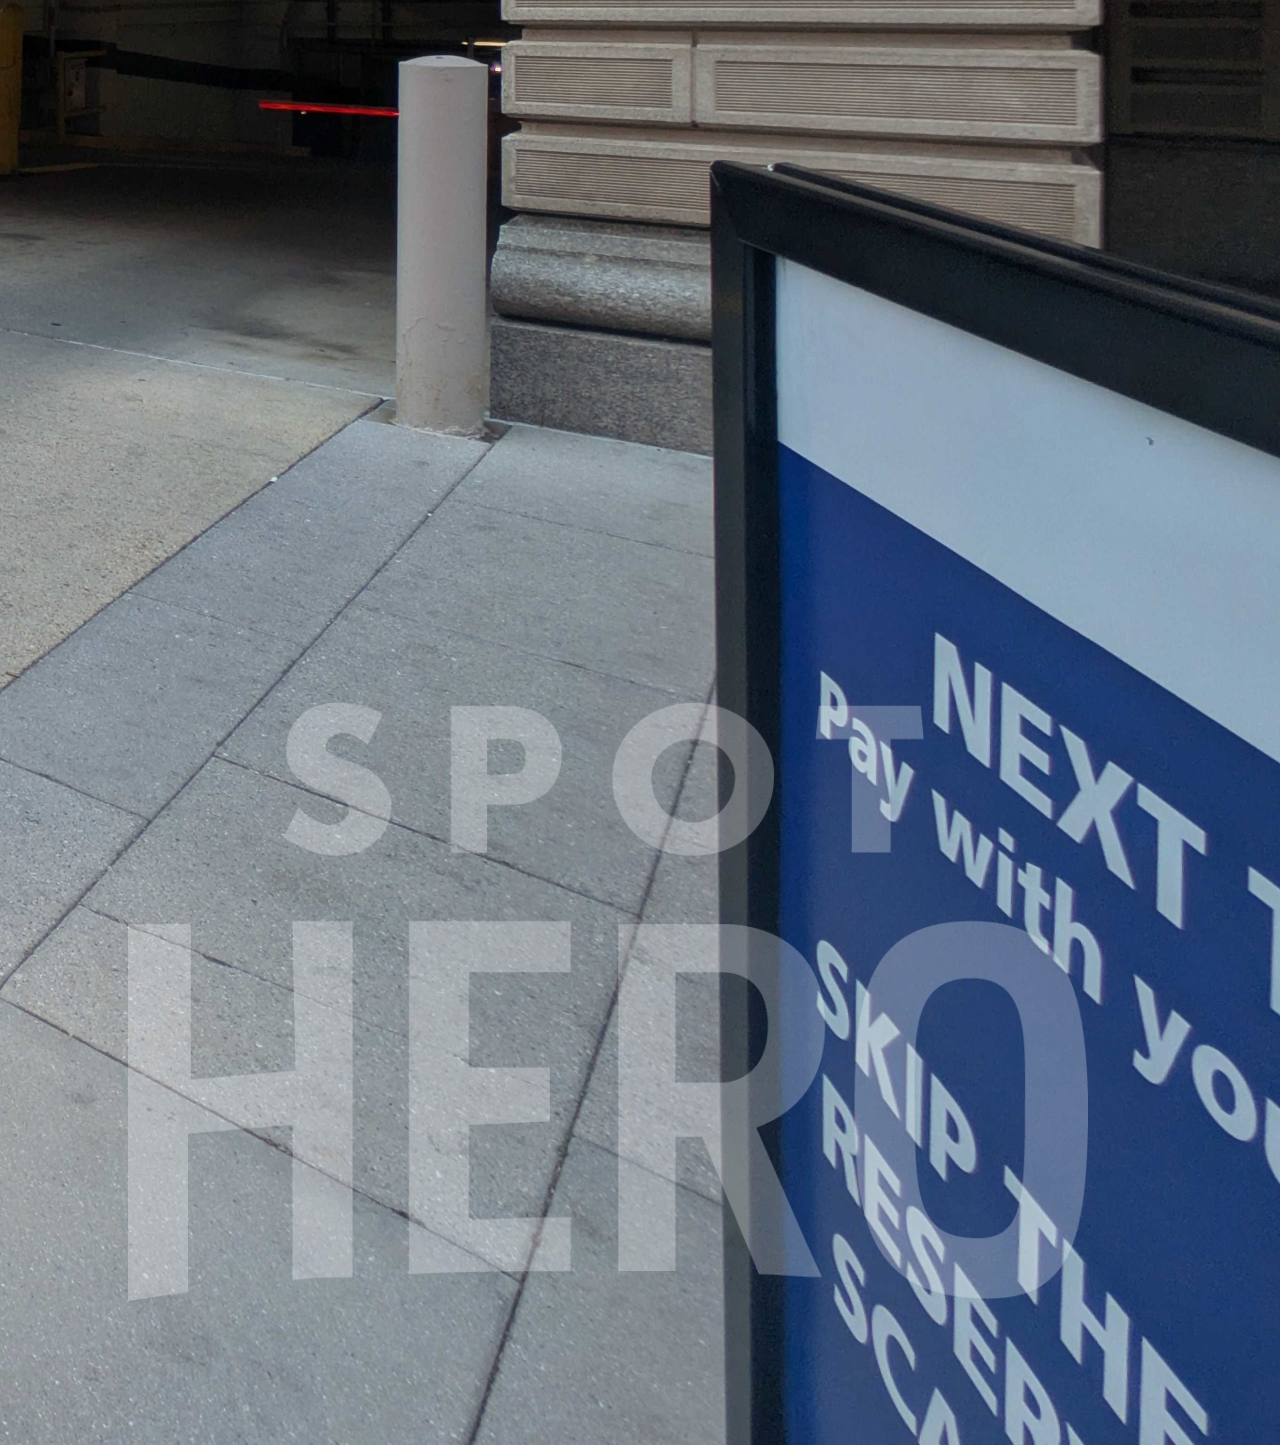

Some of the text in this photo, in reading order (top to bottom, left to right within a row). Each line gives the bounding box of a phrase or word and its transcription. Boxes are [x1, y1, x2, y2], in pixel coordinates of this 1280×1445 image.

[820, 671, 915, 823] Pay
[932, 788, 1103, 1006] with
[1132, 973, 1280, 1184] yo
[933, 632, 1207, 930] NEXT
[816, 939, 1209, 1445] SKIP THE
[822, 1073, 1085, 1445] RESER
